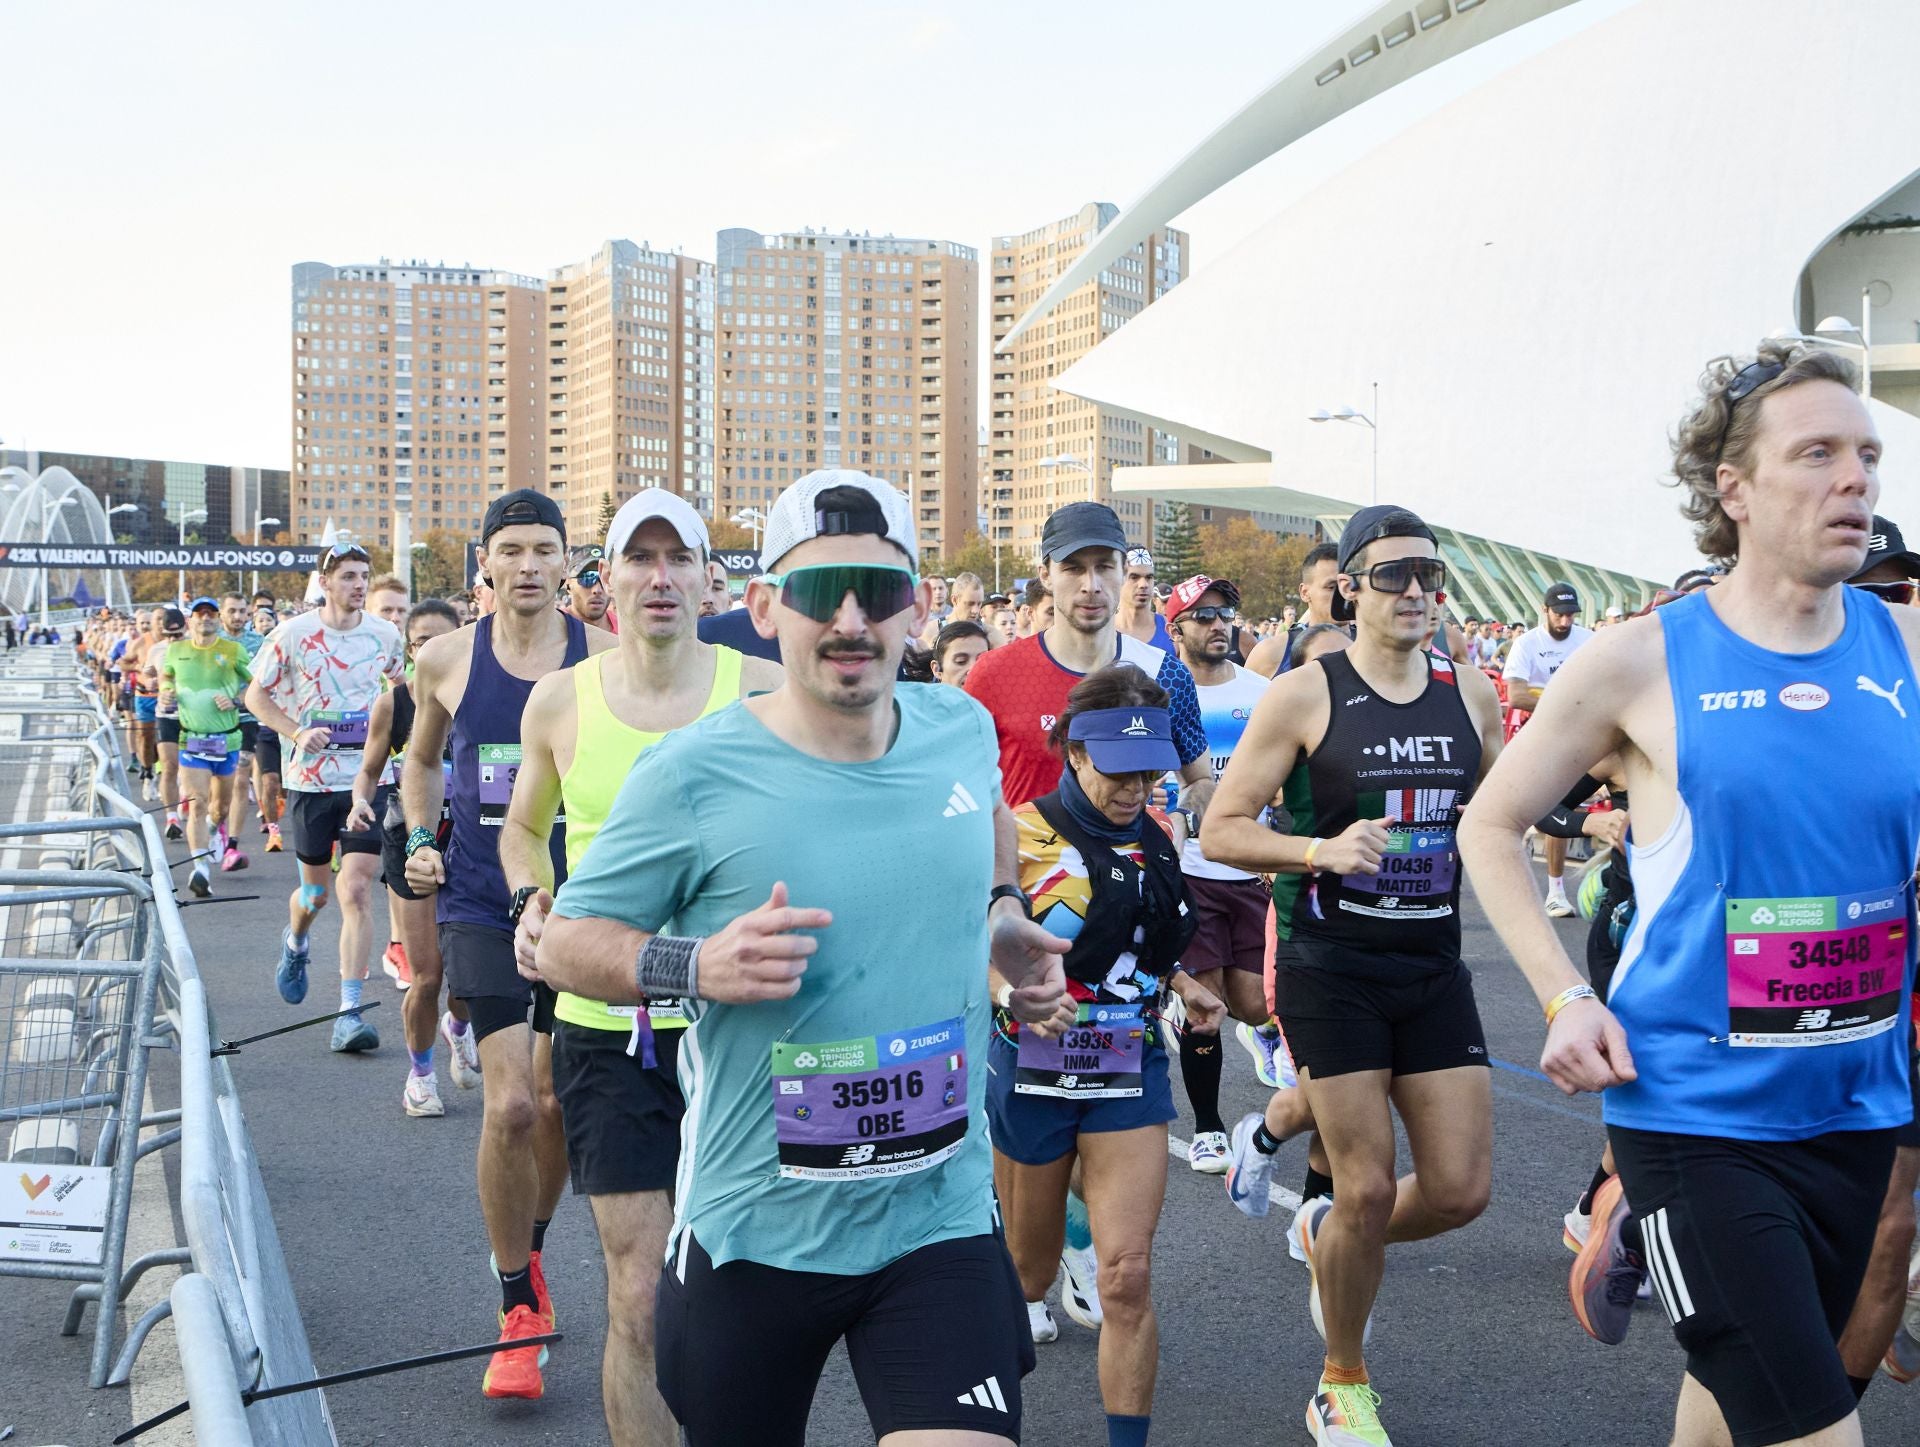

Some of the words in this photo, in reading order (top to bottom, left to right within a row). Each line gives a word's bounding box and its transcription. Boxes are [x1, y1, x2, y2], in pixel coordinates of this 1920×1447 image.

[8, 547, 39, 563] 42K
[39, 548, 107, 565] VALENCIA
[109, 549, 196, 566] TRINIDAD
[194, 550, 276, 566] ALFONSO
[1740, 688, 1767, 709] 78
[1783, 690, 1826, 702] Henkel
[1389, 736, 1454, 763] MET
[1368, 769, 1393, 777] nostra
[1382, 857, 1433, 875] 10436
[1376, 878, 1432, 893] MATTEO
[1777, 910, 1824, 918] TRINIDAD
[1863, 898, 1895, 914] ZURICH
[1778, 918, 1824, 927] ALFONSO
[1789, 935, 1871, 969] 34548
[1767, 977, 1853, 1002] Freccia
[1859, 968, 1886, 995] BW
[1109, 1012, 1134, 1020] ZURICH
[910, 1030, 950, 1050] ZURICH
[820, 1051, 864, 1062] TRINIDAD
[821, 1059, 865, 1069] ALFONSO
[1063, 1054, 1100, 1070] INMA
[832, 1070, 924, 1110] 35916
[857, 1110, 906, 1137] OBE
[877, 1154, 894, 1162] new
[894, 1147, 925, 1160] balance
[849, 1166, 887, 1178] TRINIDAD
[887, 1160, 924, 1173] ALFONSO
